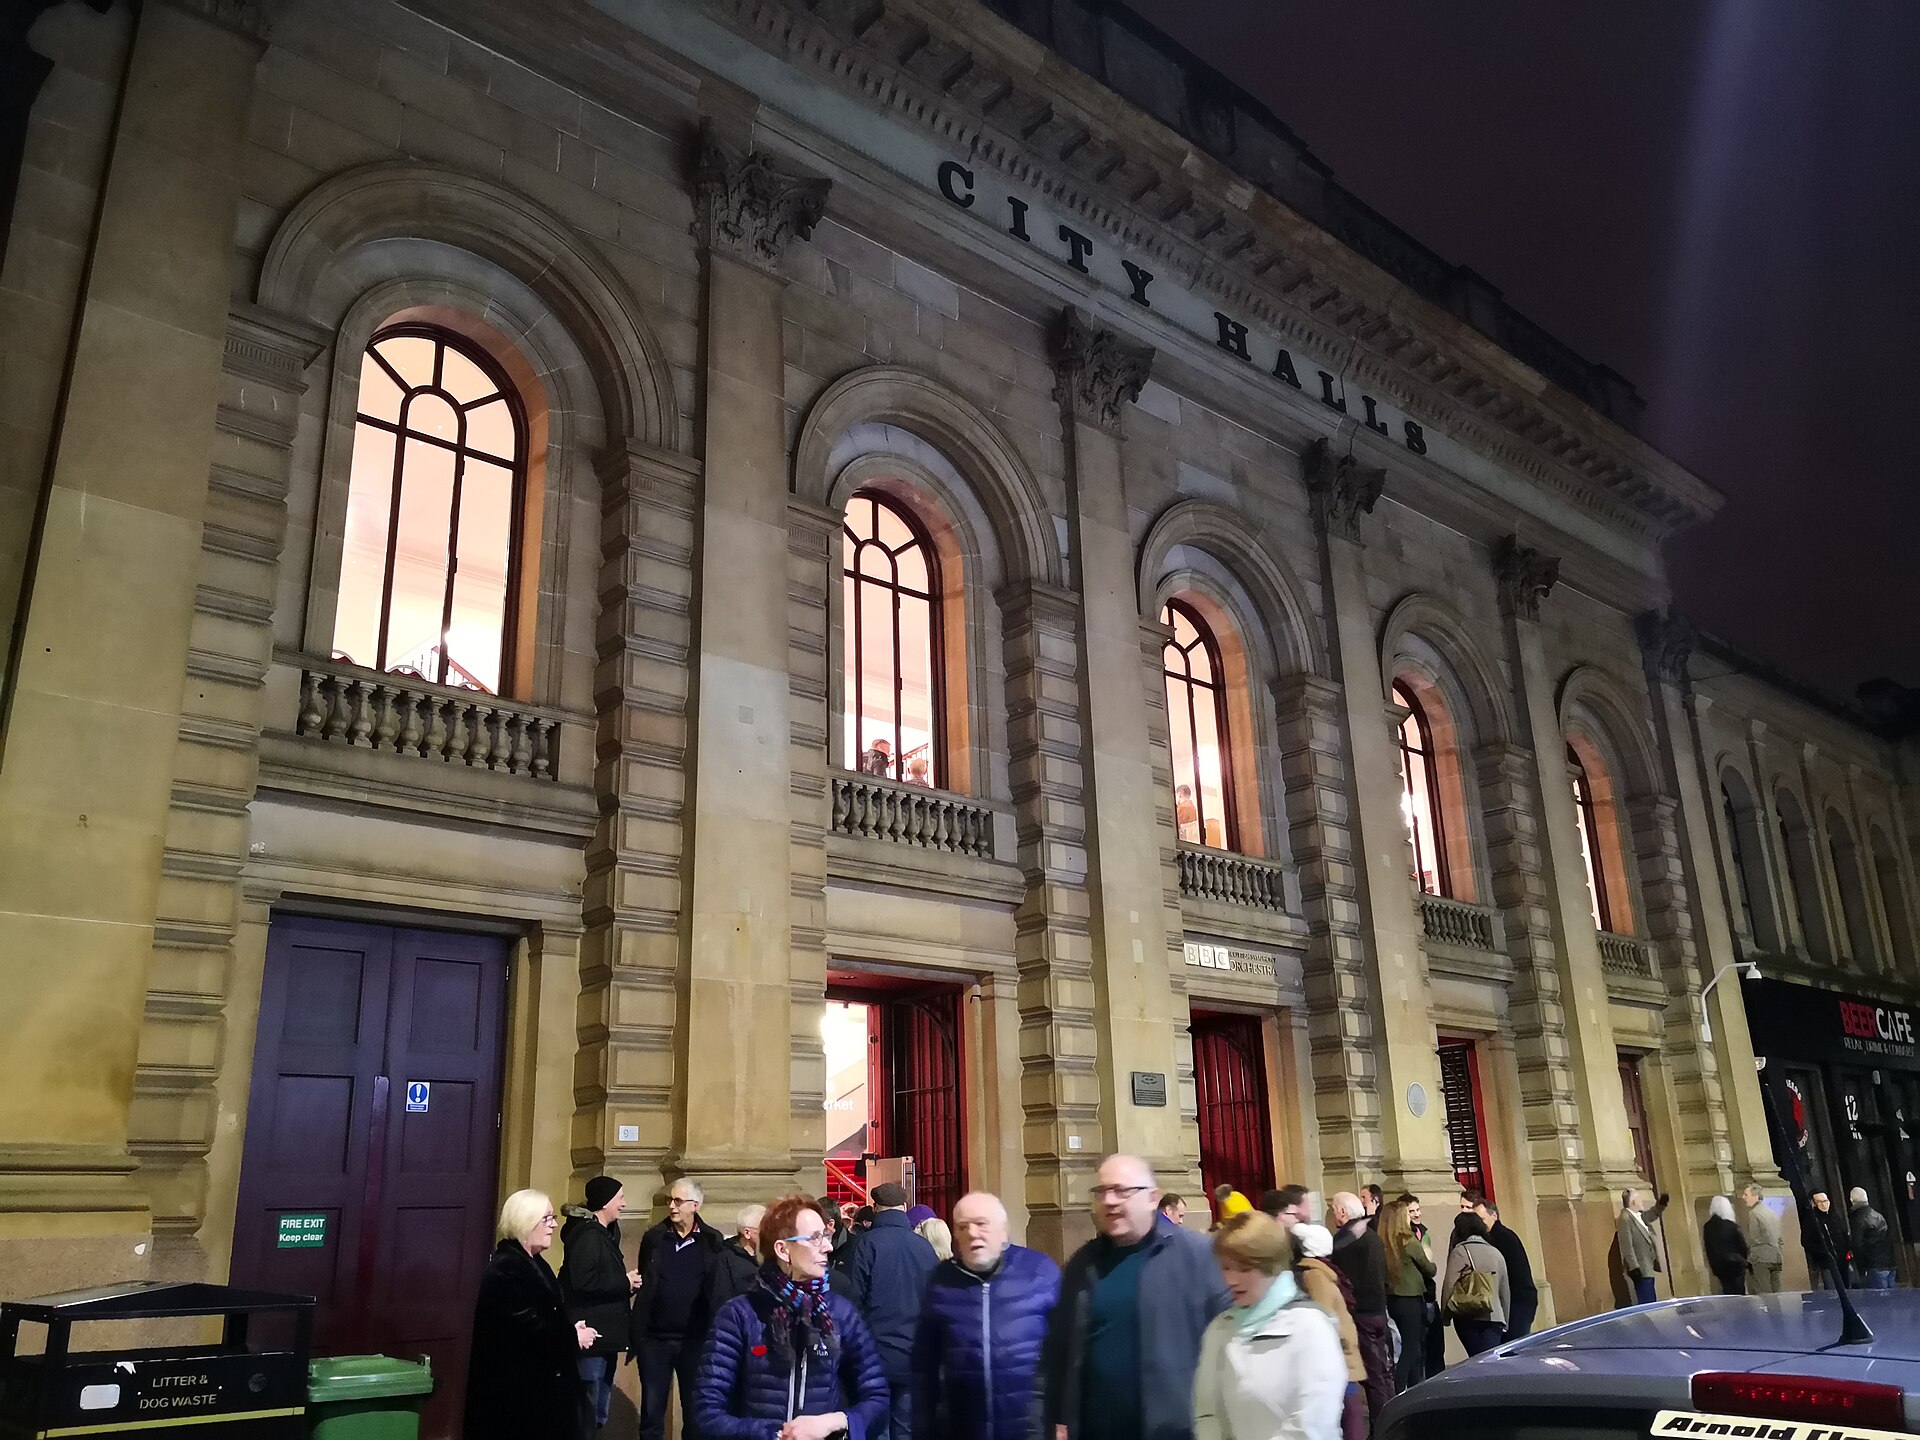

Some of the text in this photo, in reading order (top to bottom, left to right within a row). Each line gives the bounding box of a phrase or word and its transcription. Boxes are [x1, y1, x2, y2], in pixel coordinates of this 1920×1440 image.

[937, 160, 1428, 456] CITY HALLS
[1186, 944, 1228, 967] BBC
[1229, 959, 1278, 977] ORCHESTRA
[1839, 999, 1915, 1044] BEER CAFE
[281, 1218, 325, 1229] FIRE EXIT
[279, 1233, 324, 1243] Keep clear
[152, 1374, 208, 1388] LITTER &
[139, 1393, 218, 1410] DOG WASTE
[1661, 1416, 1798, 1440] Arnold
